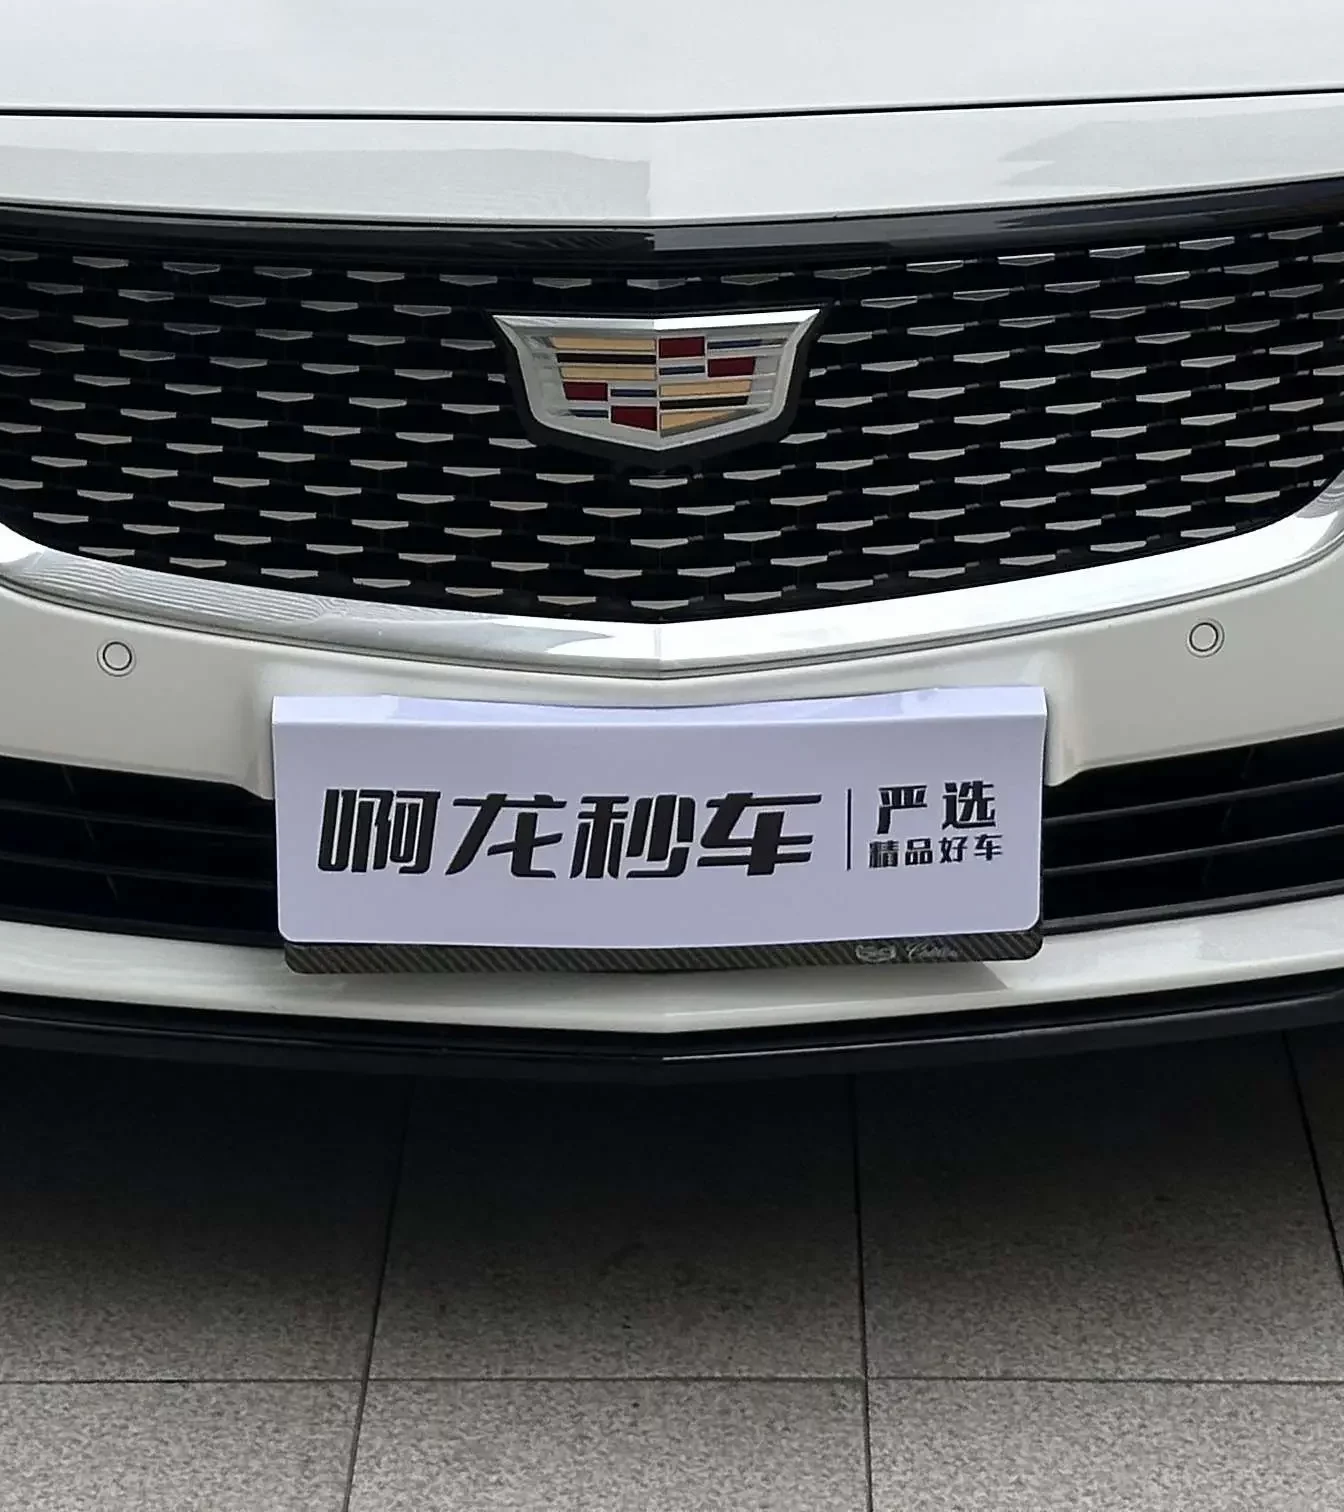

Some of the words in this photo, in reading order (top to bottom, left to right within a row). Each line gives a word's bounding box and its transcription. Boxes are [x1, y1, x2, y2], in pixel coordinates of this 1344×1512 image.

[317, 788, 822, 879] 啊龙秒车
[876, 779, 997, 835] 严选
[868, 834, 1004, 869] 精品好车
